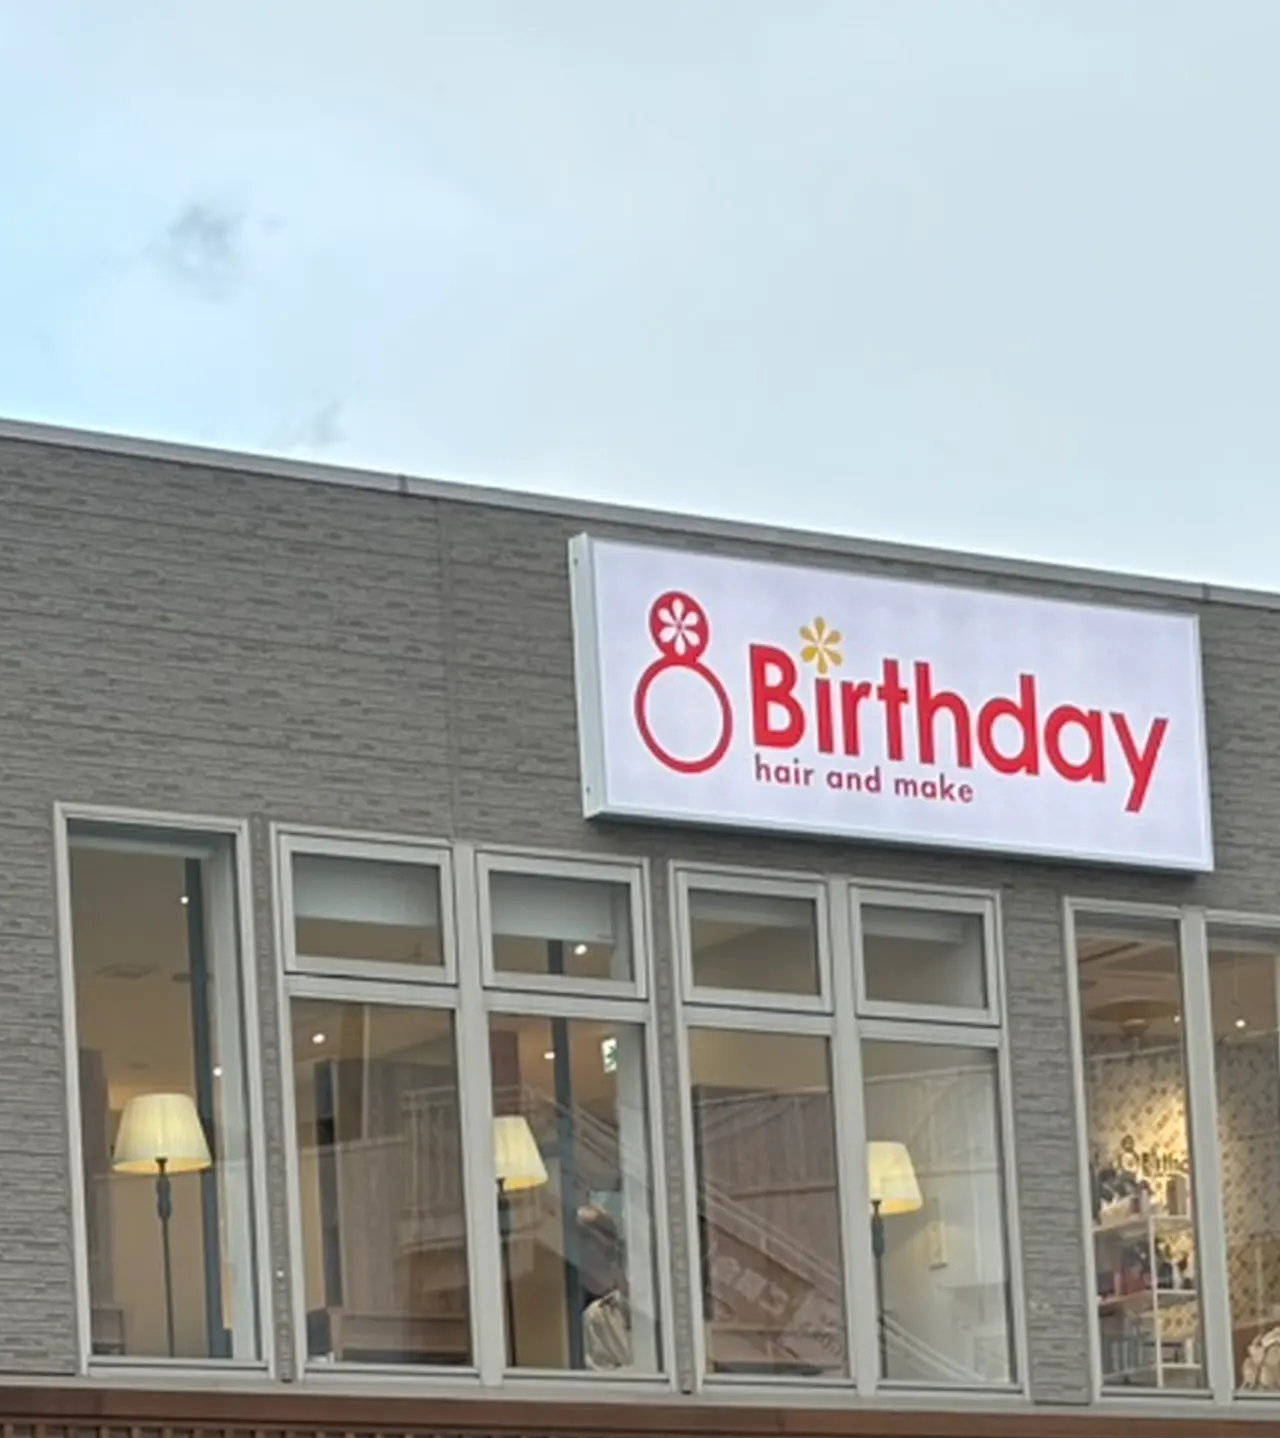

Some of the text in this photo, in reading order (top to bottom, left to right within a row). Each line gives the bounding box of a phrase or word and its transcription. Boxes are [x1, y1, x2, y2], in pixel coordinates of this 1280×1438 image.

[748, 641, 1169, 813] Birthday
[754, 753, 975, 803] hair and make
